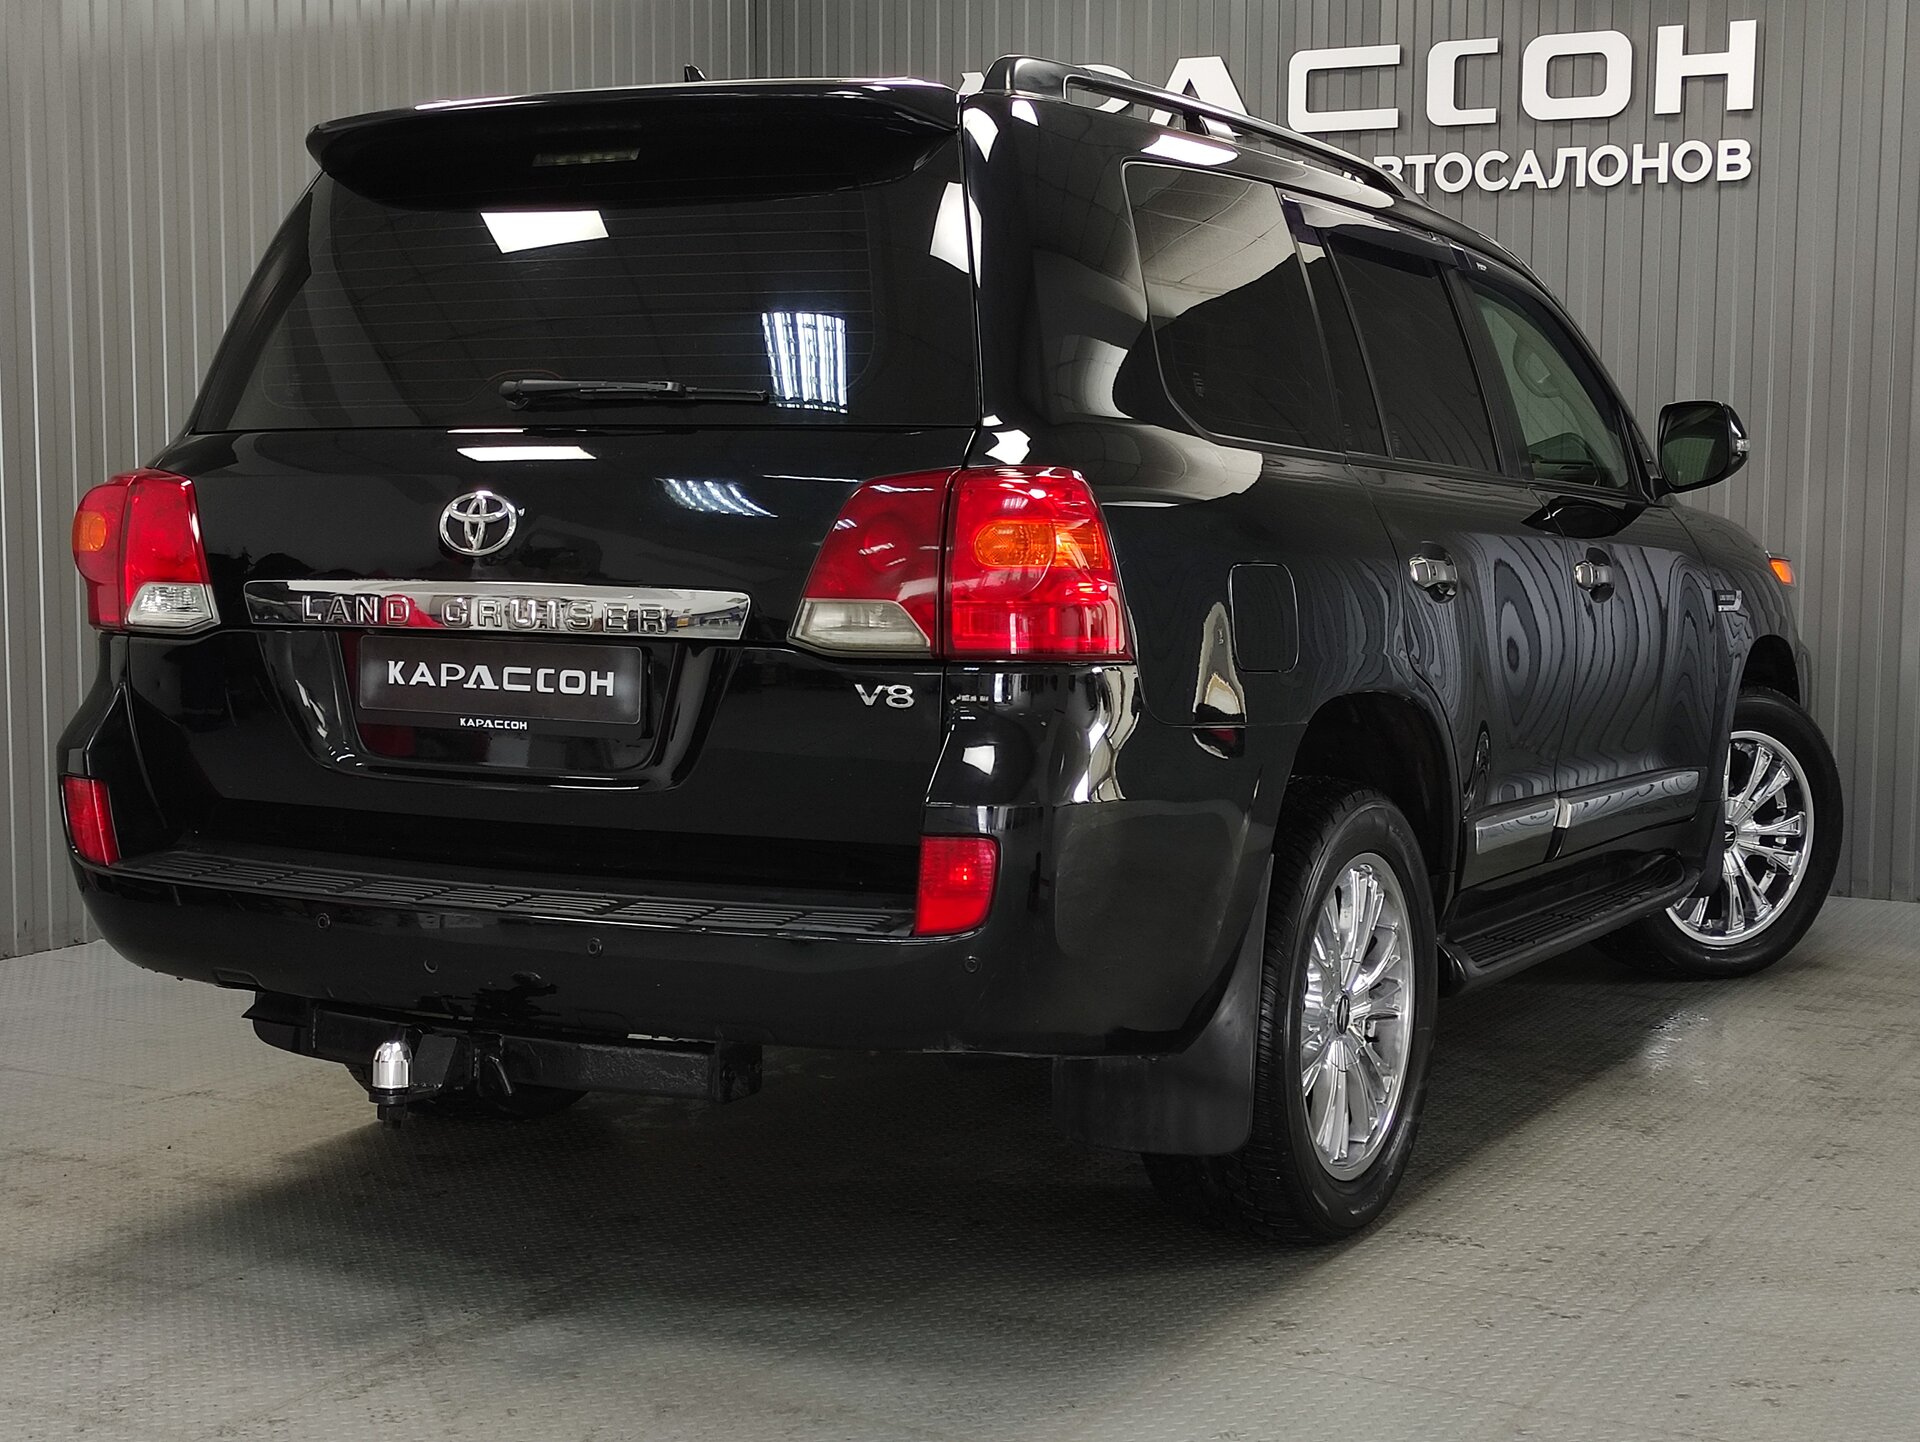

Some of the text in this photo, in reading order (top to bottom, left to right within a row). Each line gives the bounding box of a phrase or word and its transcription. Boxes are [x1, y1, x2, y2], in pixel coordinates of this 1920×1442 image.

[301, 594, 670, 635] LAND CRUISER
[388, 660, 615, 697] КАРАССОН
[854, 683, 915, 709] V8
[459, 717, 528, 731] КАРАССОН
